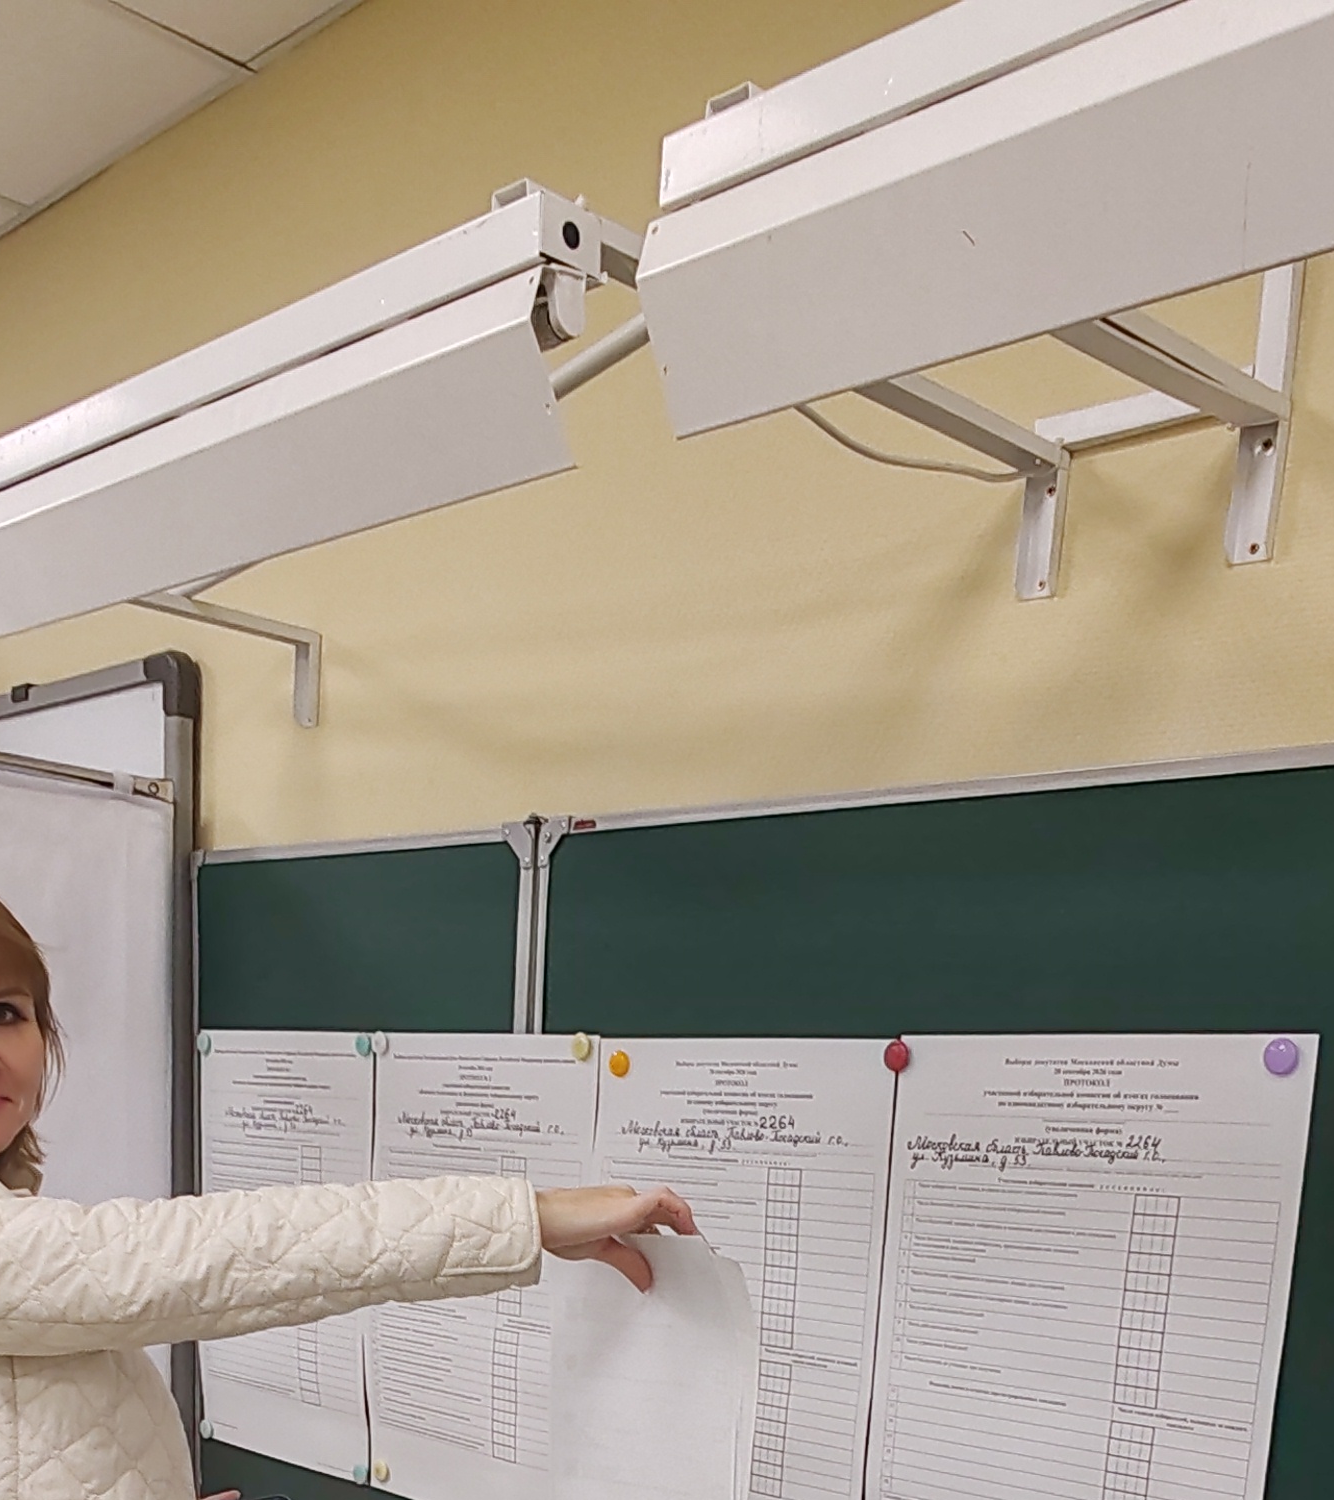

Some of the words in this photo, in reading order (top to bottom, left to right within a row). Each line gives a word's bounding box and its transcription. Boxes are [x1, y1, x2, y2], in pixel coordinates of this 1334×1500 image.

[759, 1115, 795, 1130] 2264
[907, 1133, 980, 1153] Московская
[1125, 1135, 1163, 1150] 2264
